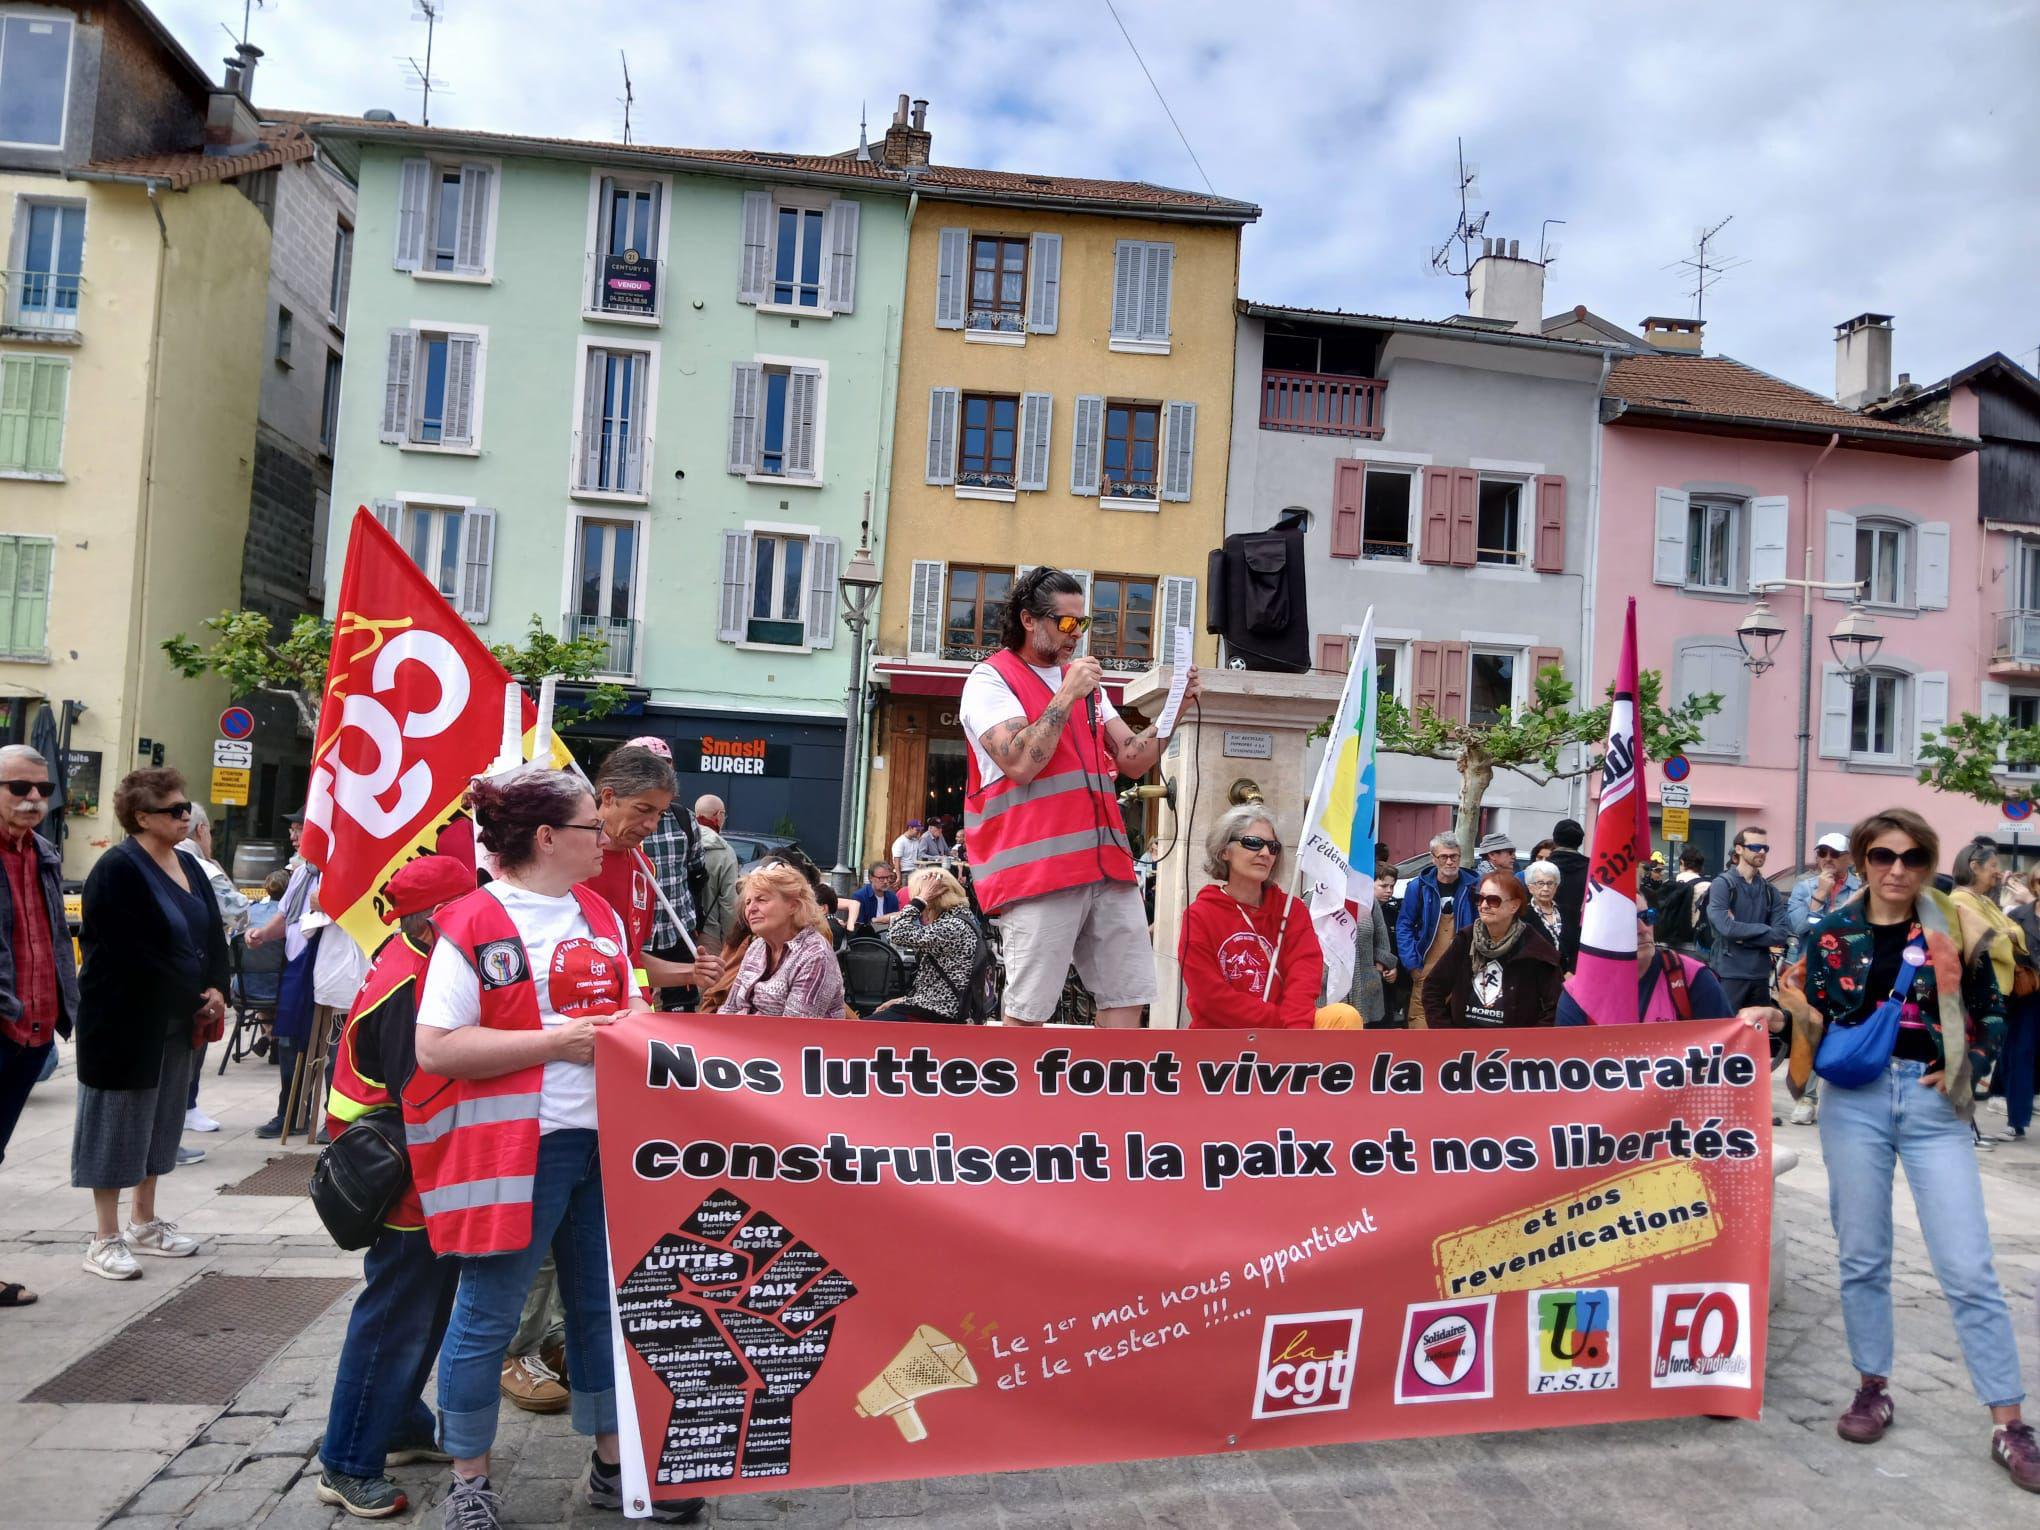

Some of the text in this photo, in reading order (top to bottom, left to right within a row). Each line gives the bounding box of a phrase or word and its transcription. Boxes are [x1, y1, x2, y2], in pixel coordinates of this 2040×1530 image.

[611, 263, 641, 273] CENTURY
[617, 281, 642, 290] VENDU
[700, 755, 764, 775] BURGER
[647, 1040, 1756, 1097] Nos luttes font vivre la démocratie
[633, 1118, 1757, 1191] construisent la paix et nos libertés
[703, 1200, 737, 1208] Dignité
[697, 1211, 741, 1222] Unité
[1523, 1187, 1621, 1236] et nos
[739, 1225, 784, 1239] CGT
[654, 1243, 706, 1254] Egalité
[732, 1238, 782, 1250] Droits
[1450, 1199, 1709, 1295] revendications
[646, 1253, 734, 1270] LUTTES
[692, 1272, 738, 1281] CGT-FO
[764, 1272, 802, 1281] Dignité
[617, 1284, 677, 1295] Résistance
[750, 1283, 797, 1297] PAIX
[991, 1334, 1029, 1360] Le
[1092, 1295, 1149, 1331] mai
[1160, 1270, 1232, 1309] nous
[1243, 1207, 1378, 1289] appartient
[703, 1290, 738, 1298] Droits
[618, 1299, 672, 1312] olidarité
[749, 1299, 784, 1309] Équité
[629, 1314, 702, 1332] Liberté
[723, 1316, 763, 1326] Dignité
[781, 1311, 815, 1323] FSU
[1423, 1325, 1466, 1345] Solidaires
[1657, 1291, 1739, 1378] FO
[745, 1342, 825, 1357] Retraite
[1272, 1329, 1348, 1363] la
[647, 1350, 732, 1364] Solidaires
[753, 1356, 824, 1365] Manifestation
[996, 1362, 1027, 1391] et
[1041, 1354, 1071, 1380] le
[1084, 1320, 1190, 1367] restera
[1656, 1354, 1748, 1376] la force syndicale
[667, 1369, 711, 1378] Service
[766, 1371, 811, 1382] Egalité
[1265, 1350, 1348, 1404] cgt
[669, 1380, 706, 1388] Public
[1535, 1371, 1616, 1392] F.S.U.
[768, 1387, 795, 1395] Public
[675, 1394, 744, 1409] Salaires
[750, 1416, 791, 1426] Liberté
[668, 1422, 738, 1437] Progrès
[669, 1434, 721, 1448] social
[746, 1438, 791, 1447] Solidarité
[662, 1451, 735, 1462] Travailleuses
[657, 1461, 733, 1483] Egalité
[741, 1467, 787, 1477] Sororité
